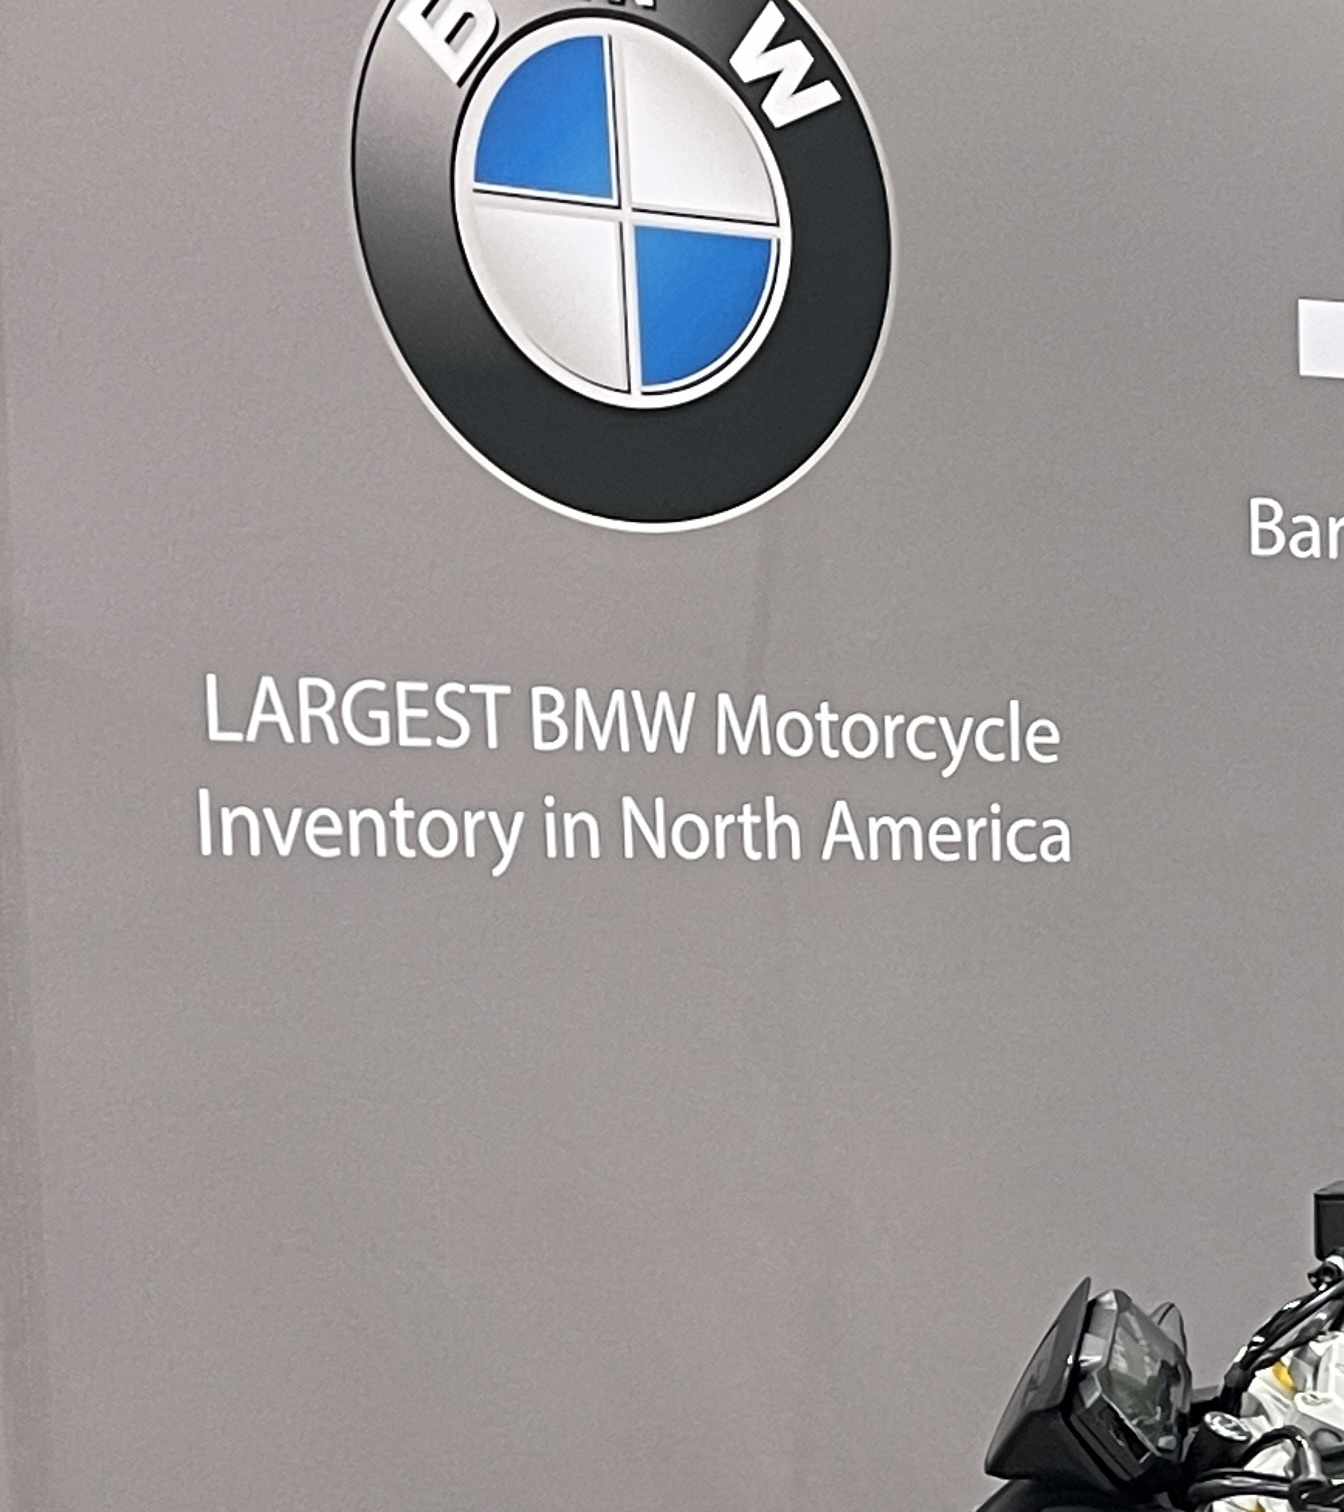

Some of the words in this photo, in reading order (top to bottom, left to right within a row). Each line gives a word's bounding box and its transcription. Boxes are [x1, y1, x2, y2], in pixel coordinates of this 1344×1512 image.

[397, 0, 842, 128] BW
[205, 672, 512, 750] LARGEST
[530, 685, 697, 755] BMW
[716, 692, 1061, 779] Motorcycle
[198, 787, 526, 878] Inventory
[543, 794, 601, 860] in
[621, 794, 802, 862] North
[821, 799, 1071, 864] America
